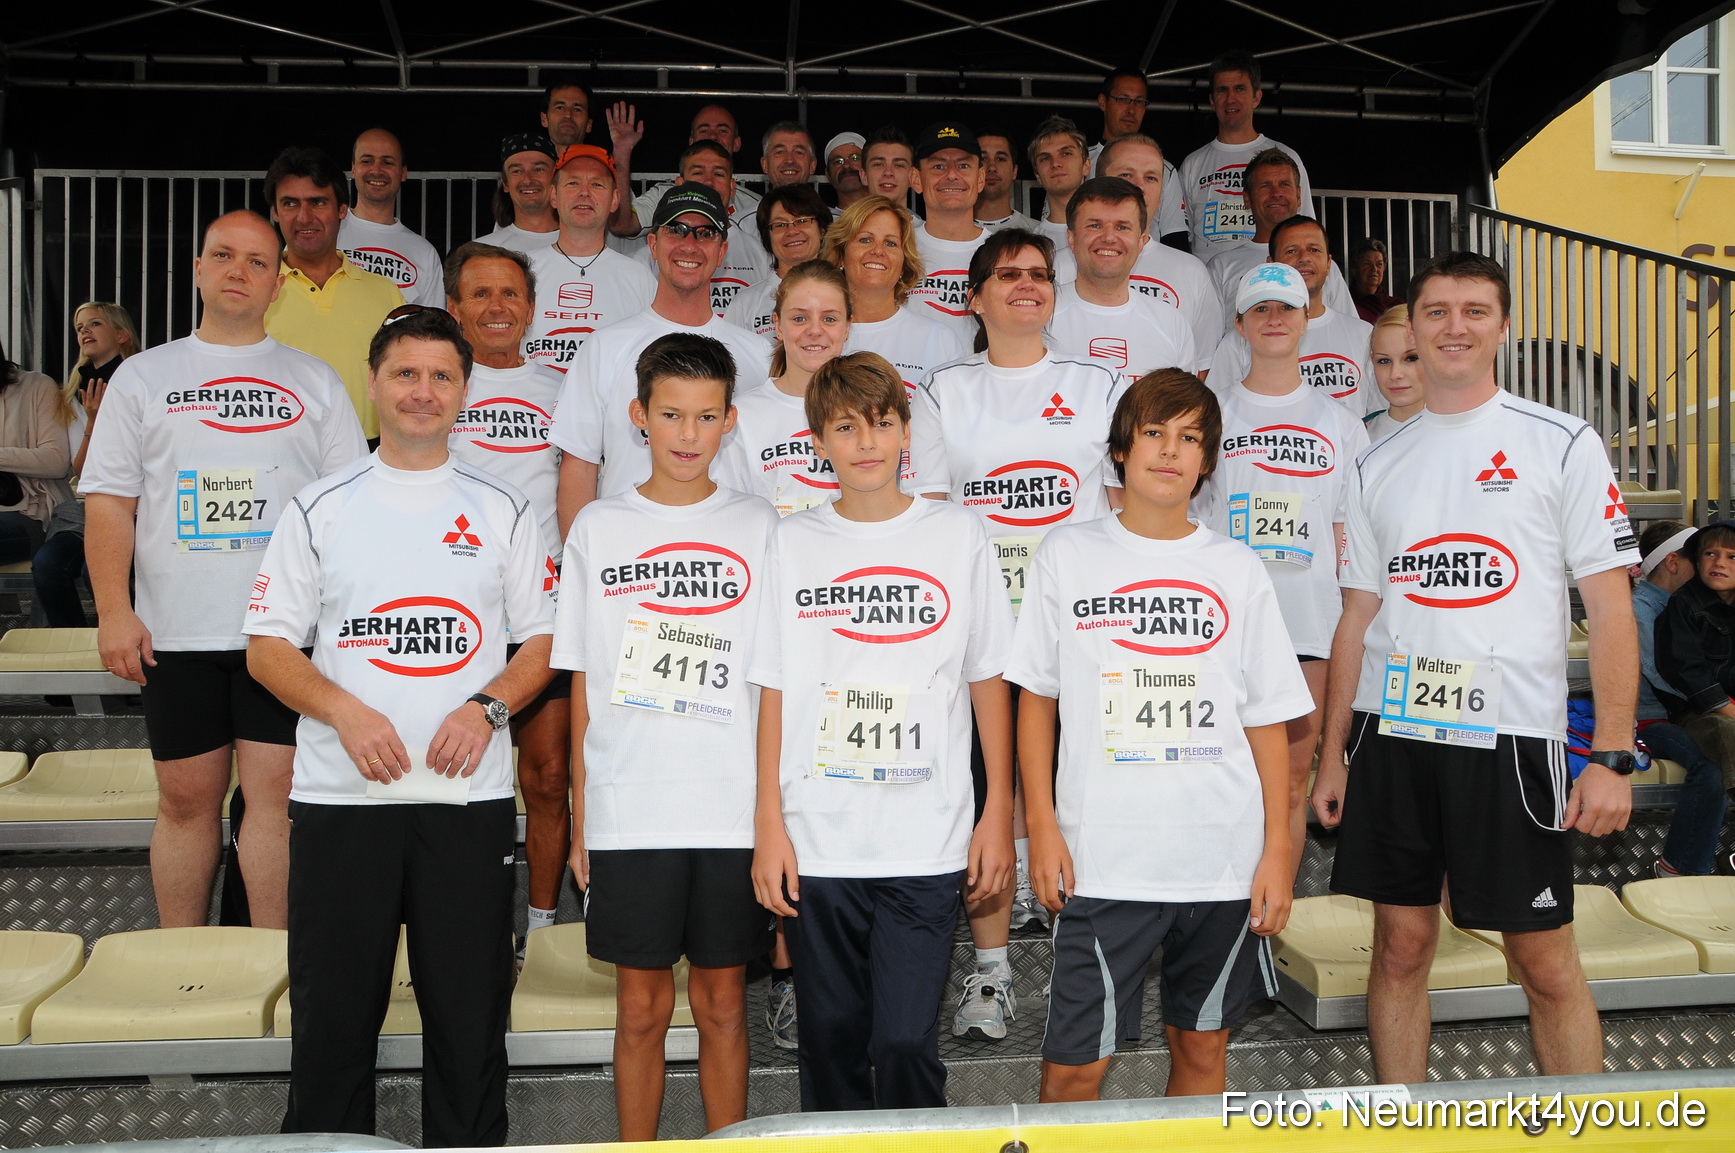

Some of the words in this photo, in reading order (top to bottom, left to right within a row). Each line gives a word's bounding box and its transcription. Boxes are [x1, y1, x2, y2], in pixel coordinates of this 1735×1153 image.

[1220, 215, 1255, 226] 2418
[338, 249, 403, 269] ERHART
[1130, 286, 1160, 297] RT
[544, 311, 603, 320] SEAT
[754, 315, 774, 328] GE
[1299, 362, 1345, 376] HART
[166, 389, 276, 404] GERHART
[166, 404, 218, 414] Autohaus
[1223, 435, 1317, 451] GERHART
[1224, 448, 1268, 459] Autohaus
[763, 458, 808, 472] Autohaus
[203, 476, 253, 491] Norbert
[964, 475, 1057, 497] GERHART
[1059, 478, 1069, 488] &
[963, 498, 1002, 506] AUTOHAUS
[1001, 490, 1071, 510] JÄNIG
[1255, 498, 1289, 513] Conny
[206, 500, 267, 522] 2427
[1235, 519, 1240, 528] C
[1256, 518, 1309, 540] 2414
[452, 550, 477, 558] MOTORS
[1488, 556, 1500, 567] &
[600, 561, 722, 585] GERHART
[726, 567, 735, 576] &
[1388, 574, 1421, 584] OHAUS
[1420, 570, 1502, 588] JÄNIG
[604, 583, 656, 597] Autohaus
[656, 580, 738, 599] JÄNIG
[796, 585, 920, 607] GERHART
[924, 592, 933, 602] &
[798, 608, 851, 619] Autohaus
[851, 605, 936, 624] JÄNIG
[1073, 597, 1203, 618] GERHART
[1207, 607, 1214, 617] &
[458, 622, 466, 633] &
[1076, 618, 1132, 630] Autohaus
[1132, 616, 1214, 639] JÄNIG
[658, 622, 732, 652] Sebastian
[337, 638, 389, 648] AUTOHAUS
[387, 636, 467, 654] JÄNIG
[625, 646, 633, 659] J
[653, 653, 729, 689] 4113
[1417, 656, 1461, 674] Walter
[1133, 669, 1195, 687] Thomas
[1391, 678, 1397, 689] C
[847, 690, 893, 714] Phillip
[1414, 682, 1485, 712] 2416
[688, 702, 732, 717] PFLEIDERER
[1105, 700, 1112, 714] J
[1136, 700, 1215, 728] 4112
[820, 718, 827, 731] J
[847, 722, 920, 749] 4111
[1449, 729, 1494, 741] PFLEIDERER
[1180, 747, 1223, 756] PFLEIDERER
[1532, 900, 1557, 908] adidas
